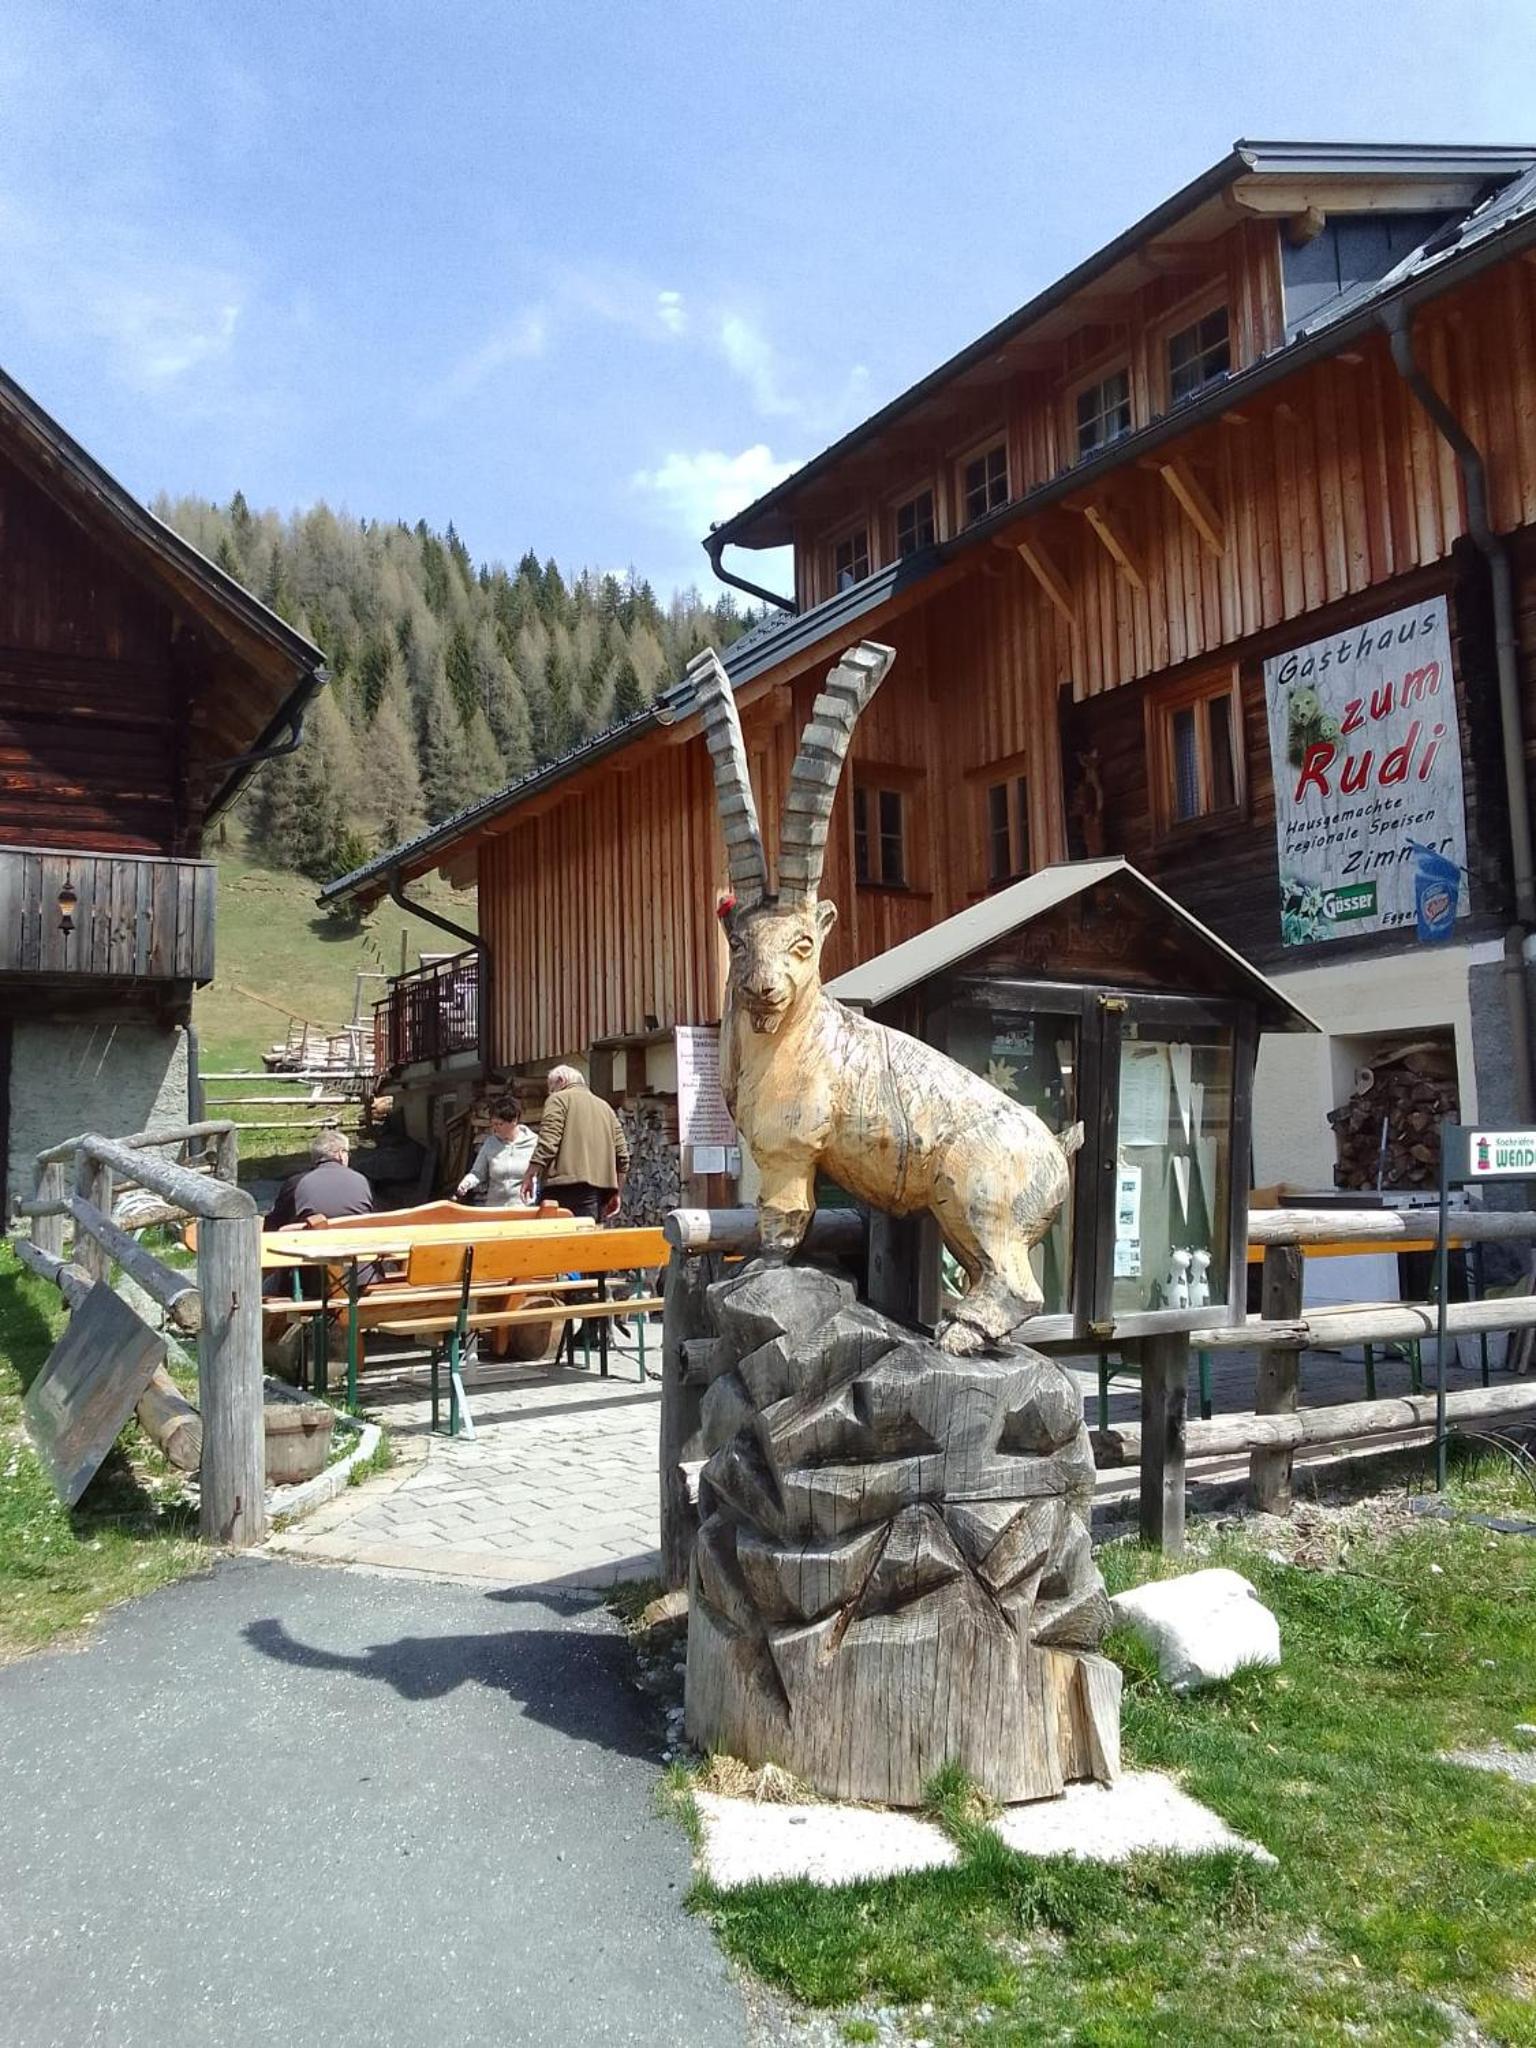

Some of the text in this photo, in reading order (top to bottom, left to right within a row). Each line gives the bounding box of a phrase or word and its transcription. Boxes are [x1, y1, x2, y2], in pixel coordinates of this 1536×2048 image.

[1279, 613, 1437, 685] Gasthaus
[1341, 660, 1443, 736] zum
[1294, 721, 1446, 804] Rudi
[1286, 798, 1403, 836] Hausgemachte
[1286, 809, 1436, 855] regionale Speisen
[1322, 892, 1374, 918] Gösser
[1496, 1149, 1536, 1168] WEND
